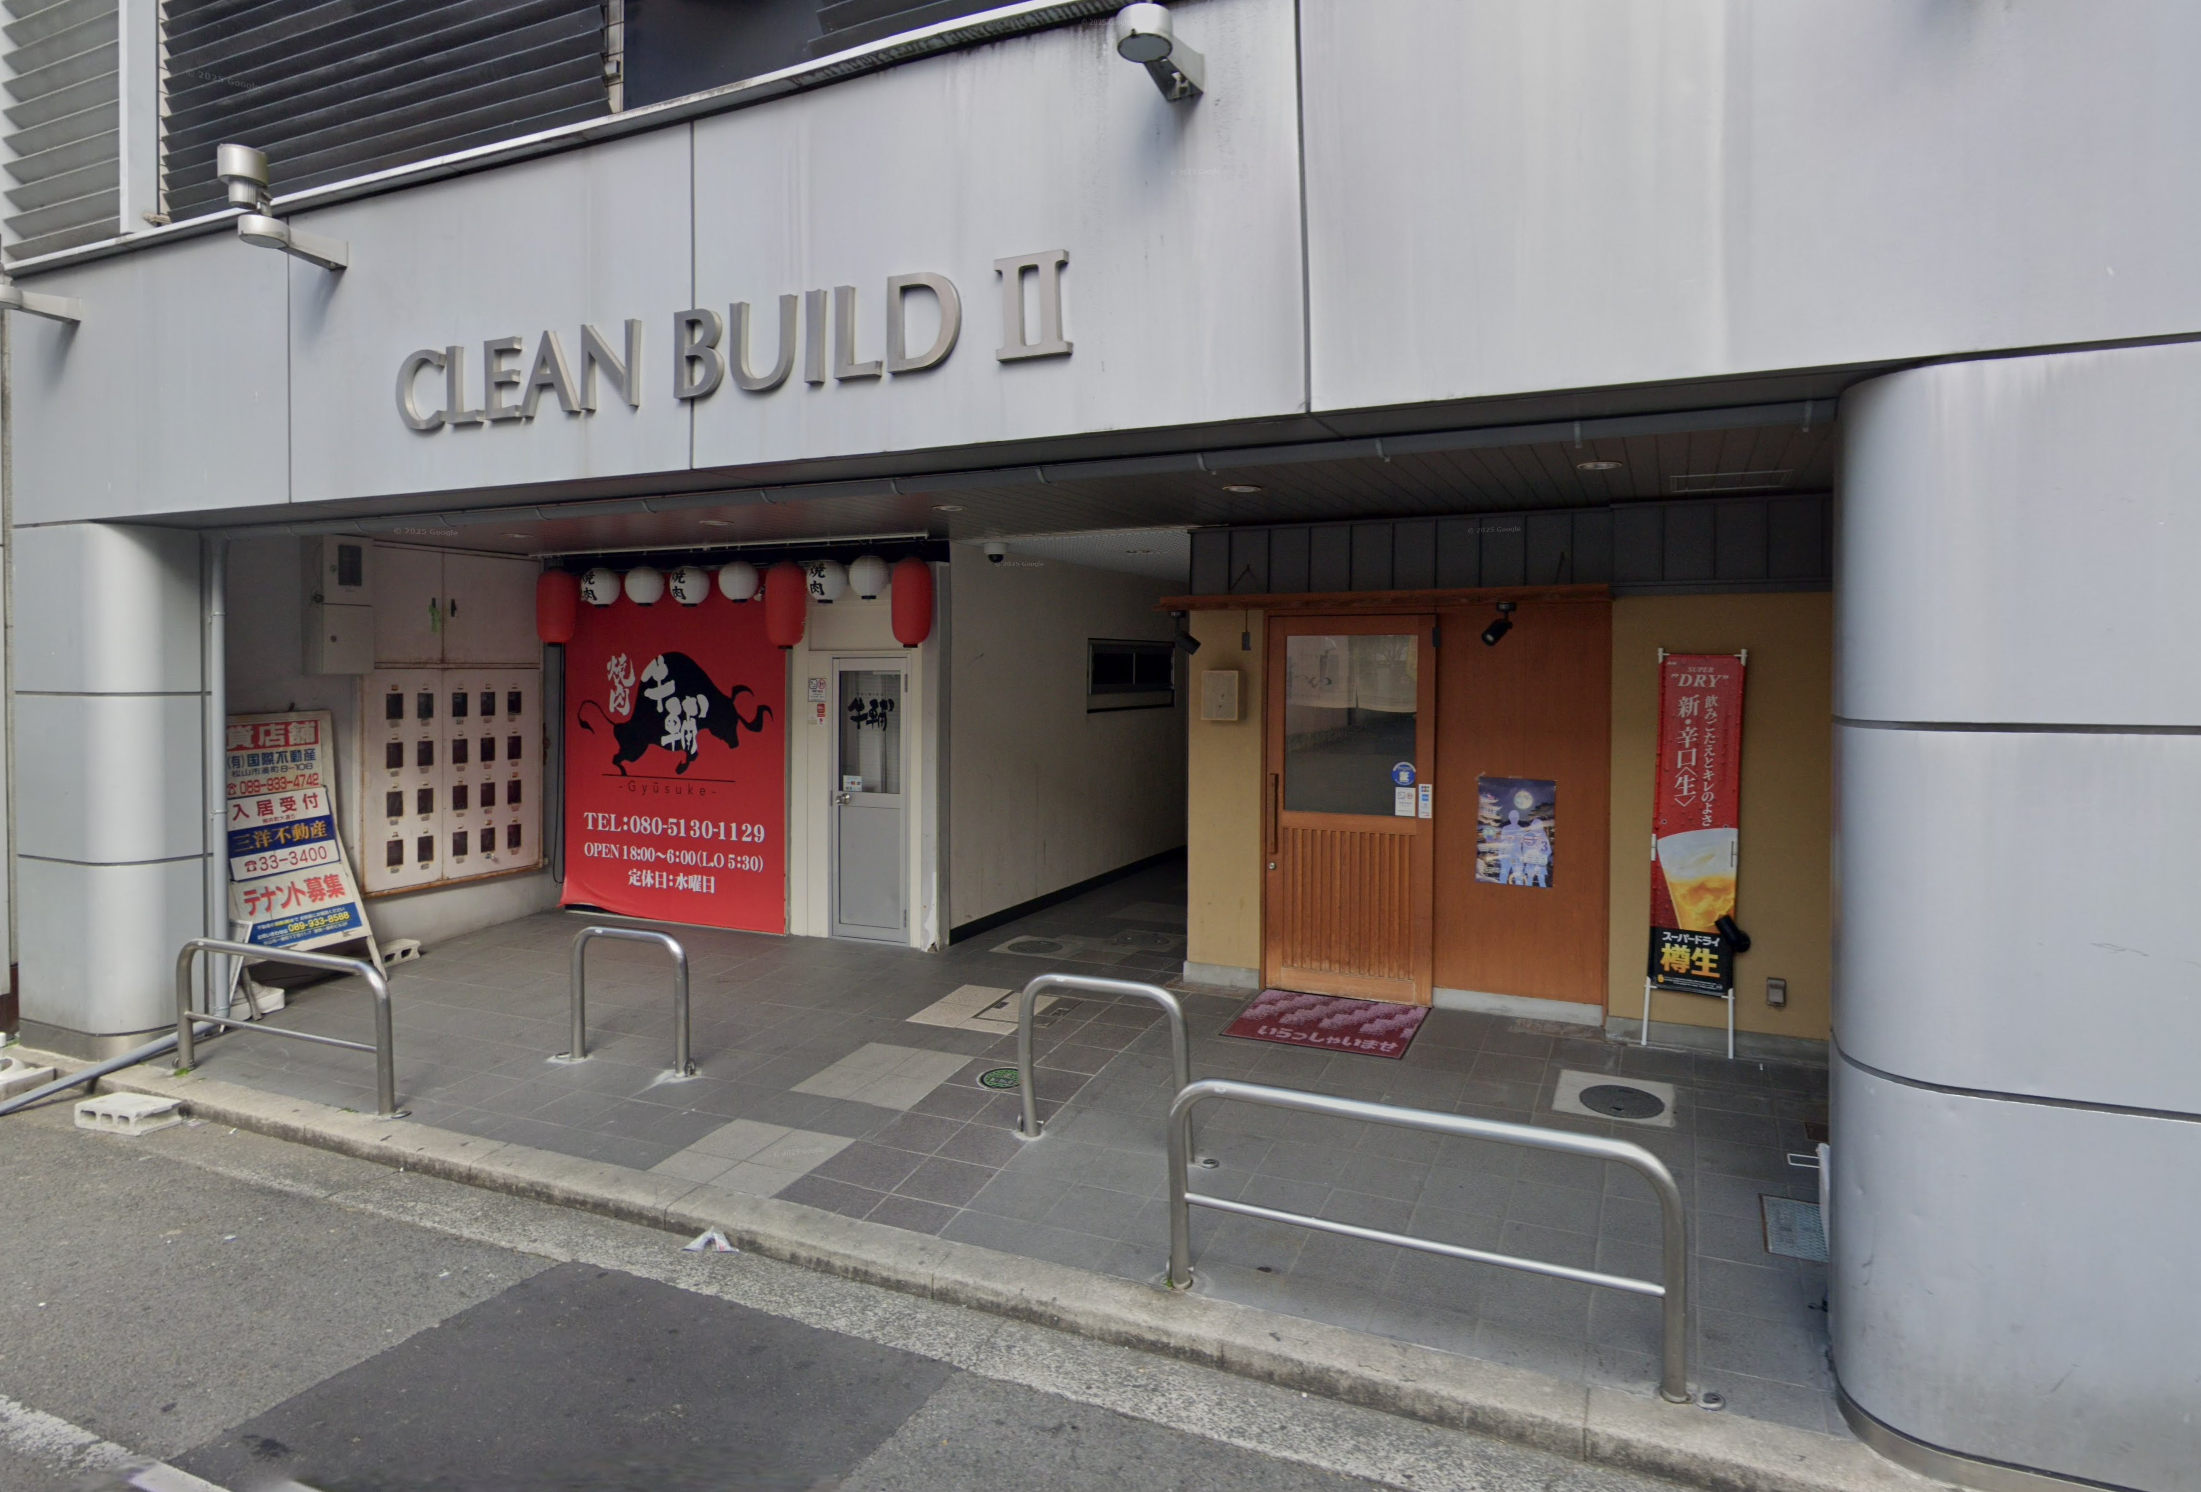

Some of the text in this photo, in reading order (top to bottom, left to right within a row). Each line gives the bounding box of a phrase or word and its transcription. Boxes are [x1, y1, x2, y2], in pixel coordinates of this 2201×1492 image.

[396, 249, 1074, 431] CLEAN BUILD II
[581, 570, 598, 601] 焼肉
[671, 568, 687, 600] 焼肉
[809, 562, 826, 596] 焼肉
[606, 652, 636, 716] 焼肉
[227, 721, 316, 749] 貸店舗
[232, 792, 319, 821] 入居受付
[232, 820, 328, 853] 三洋不動産
[583, 811, 766, 843] TEL:080-5130-1129
[584, 841, 620, 859] OPEN
[243, 873, 346, 916] テナント募集
[627, 868, 716, 894] 定休日:水曜日
[1661, 931, 1721, 947] スーパードライ
[1659, 943, 1721, 979] 樽生
[1257, 1025, 1398, 1053] いらっしゃいませ
